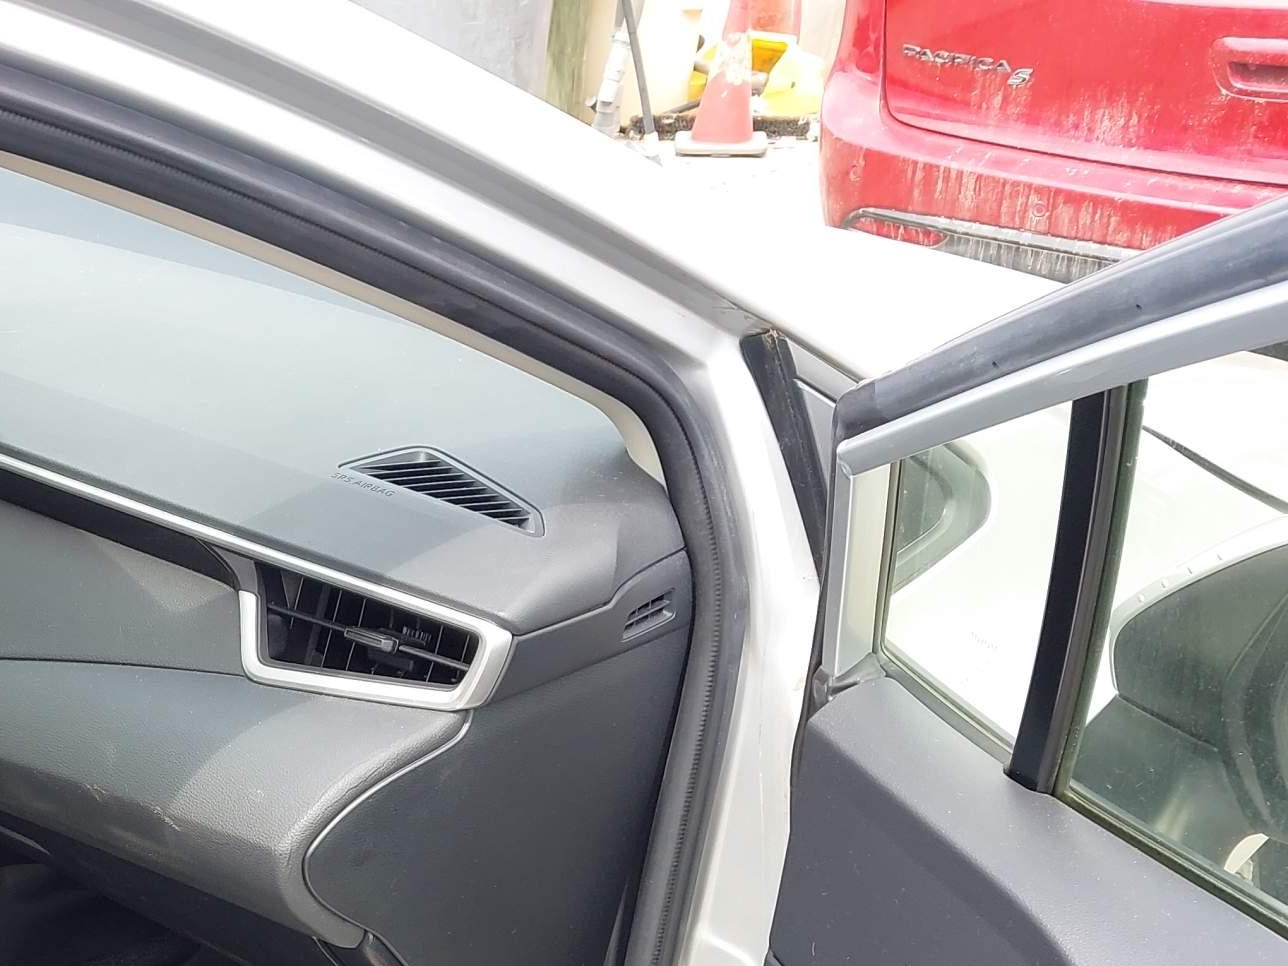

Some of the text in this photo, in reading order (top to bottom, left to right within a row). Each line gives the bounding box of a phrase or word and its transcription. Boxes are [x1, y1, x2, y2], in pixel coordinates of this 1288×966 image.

[903, 43, 1033, 87] PACIFICA S
[352, 480, 396, 497] AIRBAG
